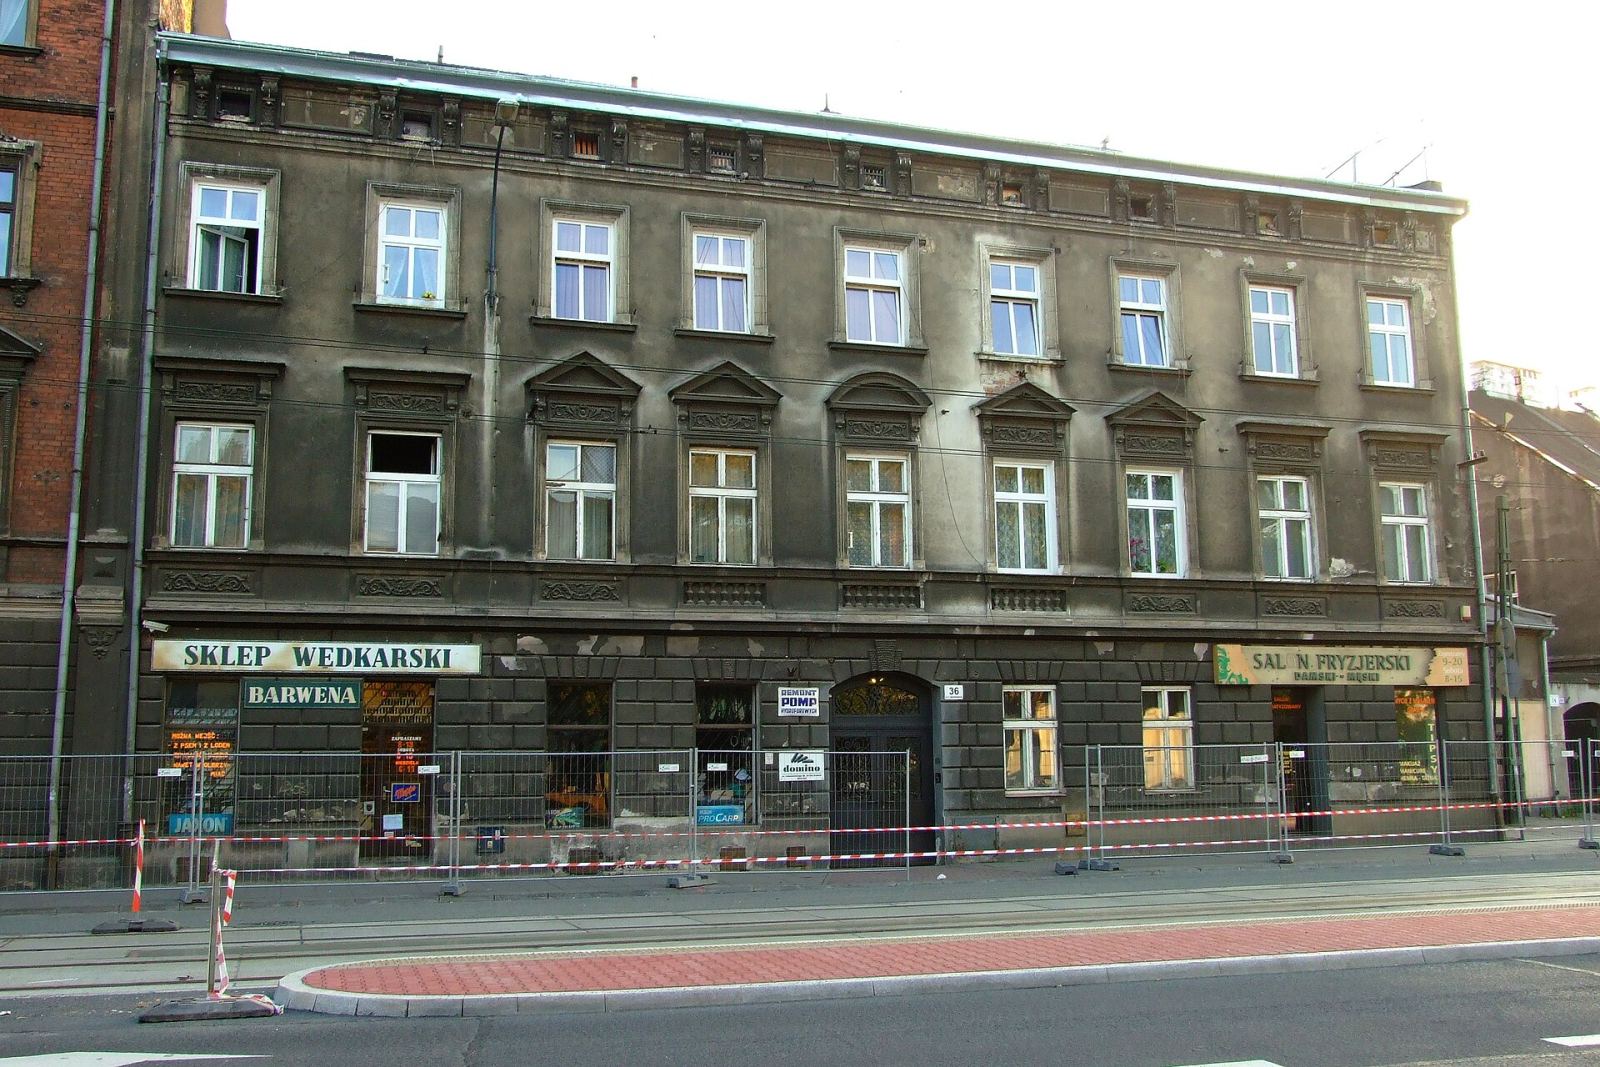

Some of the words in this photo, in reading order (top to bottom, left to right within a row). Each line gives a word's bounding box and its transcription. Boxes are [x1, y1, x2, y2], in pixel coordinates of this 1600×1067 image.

[184, 645, 272, 666] SKLEP
[1253, 653, 1309, 670] SALN
[1315, 654, 1411, 671] FRYZJERSKI
[1442, 657, 1463, 666] 9-20
[1294, 672, 1335, 681] DAMSKI
[248, 686, 357, 704] BARWENA
[949, 687, 960, 695] 36
[781, 697, 818, 706] POMP
[1428, 723, 1438, 774] TIPSY
[783, 764, 820, 773] domino
